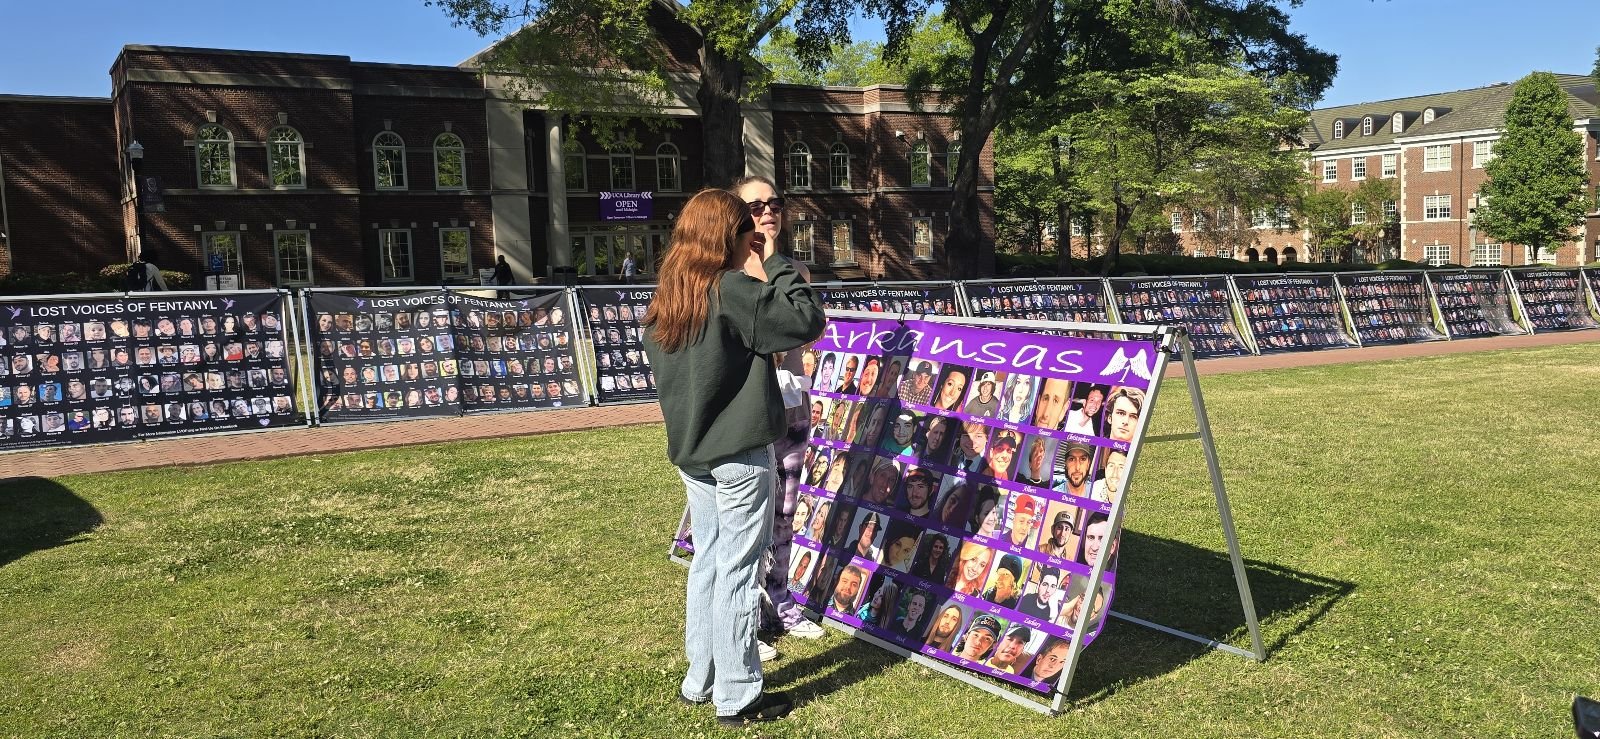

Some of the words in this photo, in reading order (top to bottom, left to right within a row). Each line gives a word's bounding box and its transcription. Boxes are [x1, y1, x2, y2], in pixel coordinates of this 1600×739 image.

[615, 200, 638, 208] OPEN
[1046, 284, 1076, 292] FENTANYL
[629, 291, 653, 300] LOST
[831, 291, 849, 299] LOST
[850, 290, 878, 298] VOICES
[888, 290, 921, 298] FENTANYL
[371, 299, 401, 309] LOST
[402, 296, 445, 306] VOICES
[448, 296, 462, 305] OF
[464, 297, 517, 309] FENTANYL
[30, 305, 68, 317] LOST
[71, 303, 124, 316] VOICES
[127, 302, 147, 313] OF
[150, 300, 218, 312] FENTANYL
[822, 322, 1084, 374] Arkansas
[1066, 434, 1091, 444] Christopher
